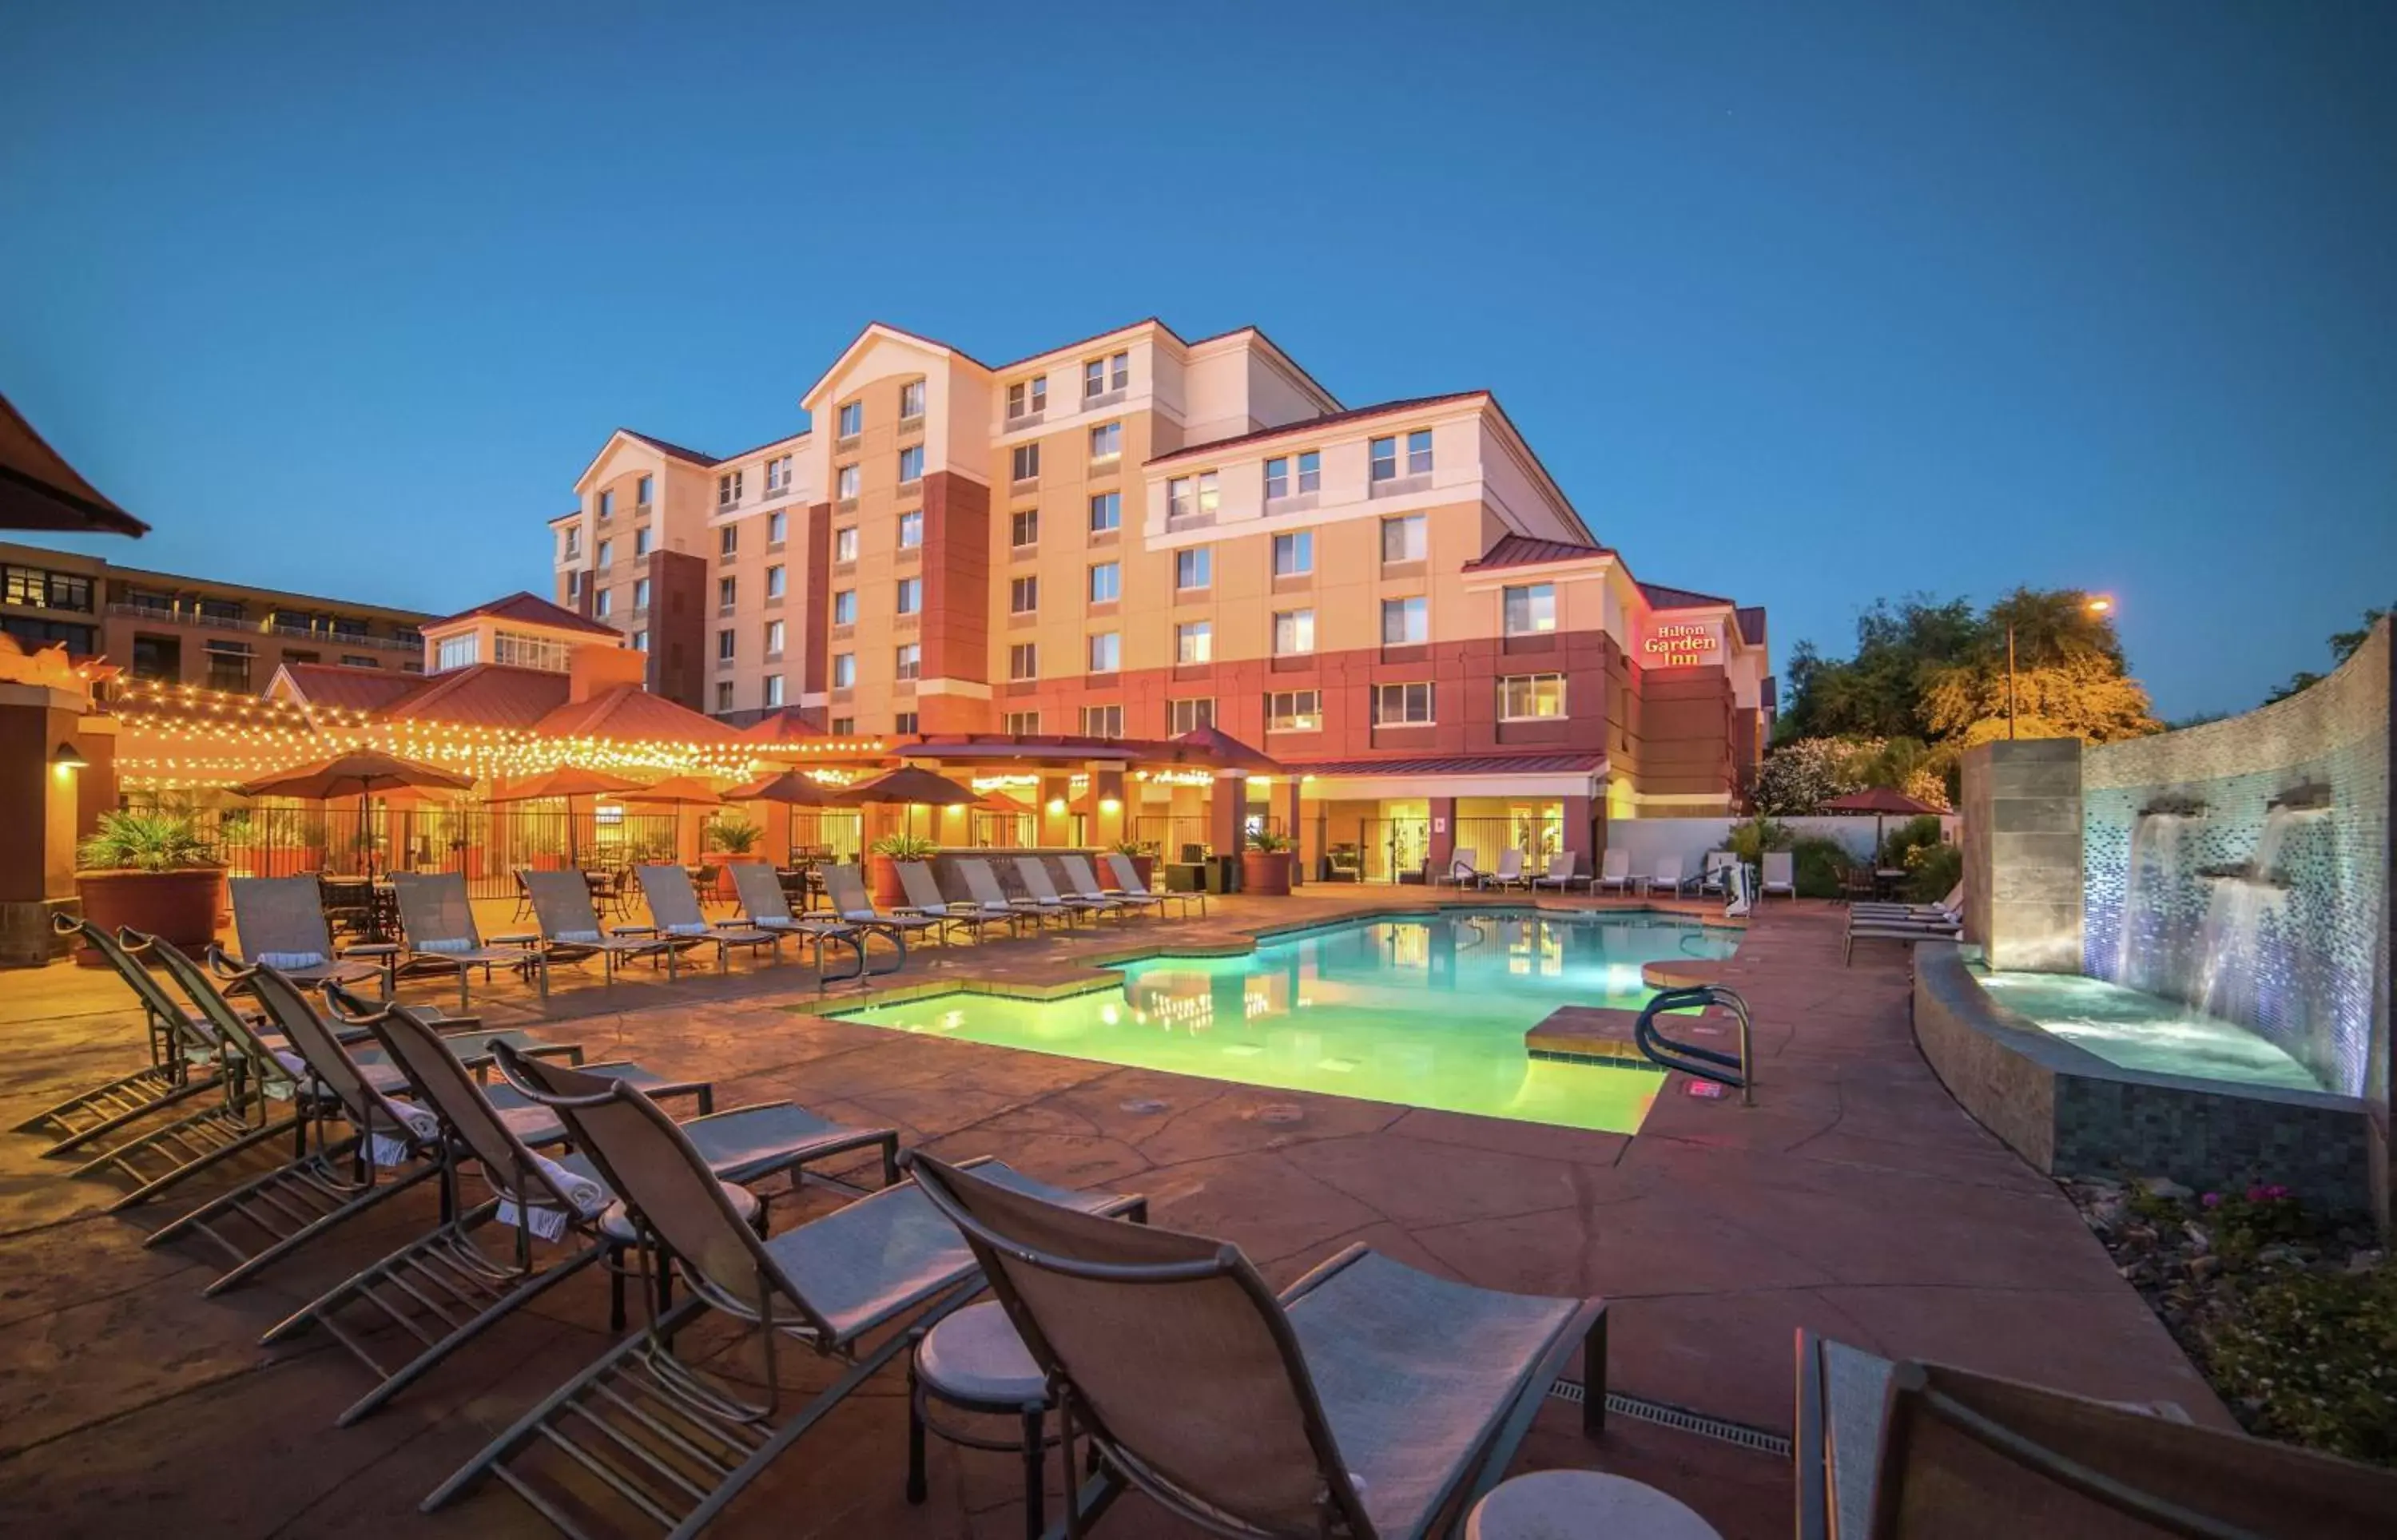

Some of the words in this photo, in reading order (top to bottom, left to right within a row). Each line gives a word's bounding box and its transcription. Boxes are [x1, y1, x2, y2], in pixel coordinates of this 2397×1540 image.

[1659, 626, 1704, 637] Hilton
[1645, 636, 1715, 652] Garden
[1664, 652, 1698, 666] Inn
